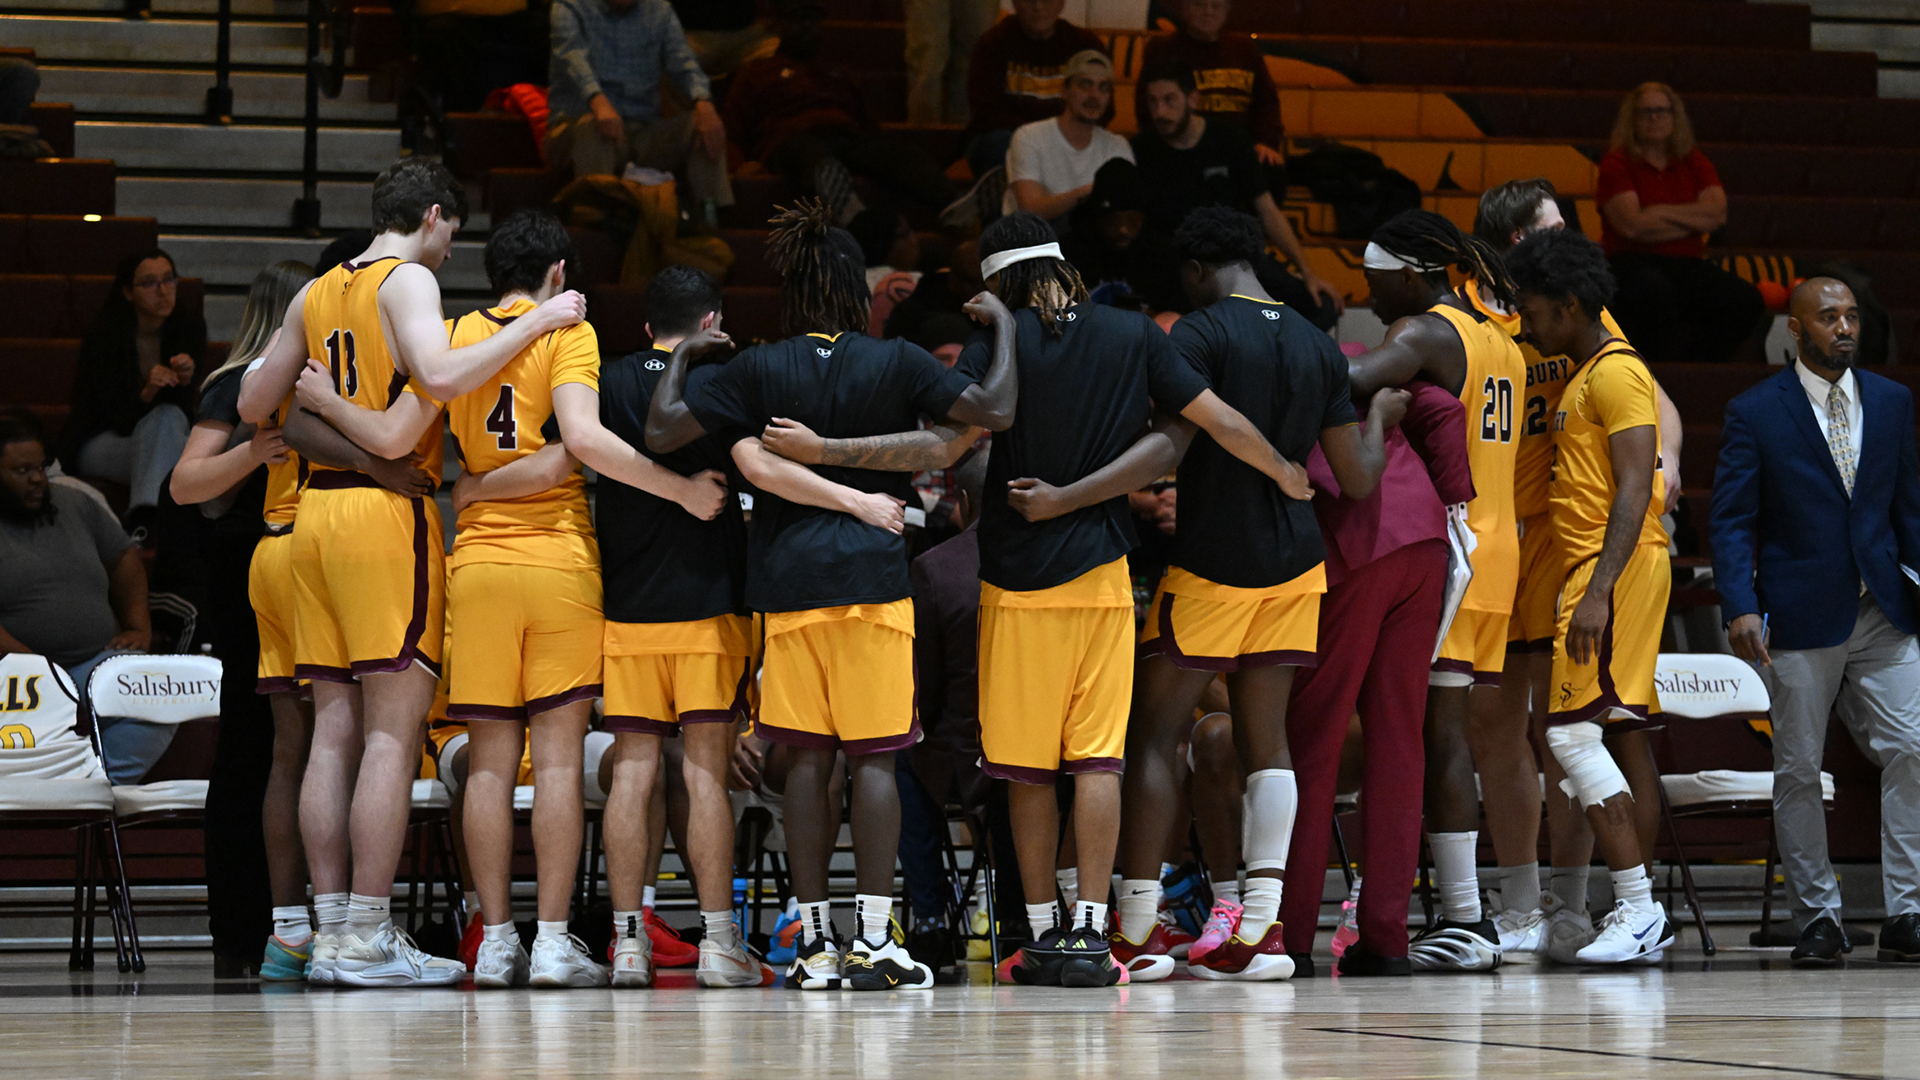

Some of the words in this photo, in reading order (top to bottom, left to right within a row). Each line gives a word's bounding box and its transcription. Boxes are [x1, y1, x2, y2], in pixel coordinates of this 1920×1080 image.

[325, 328, 359, 398] 13
[1526, 357, 1568, 388] BURY
[485, 383, 518, 450] 4
[1480, 375, 1513, 444] 20
[1521, 395, 1548, 436] 2
[0, 674, 44, 712] LS
[117, 673, 220, 702] Salisbury
[1653, 671, 1742, 699] Salisbury
